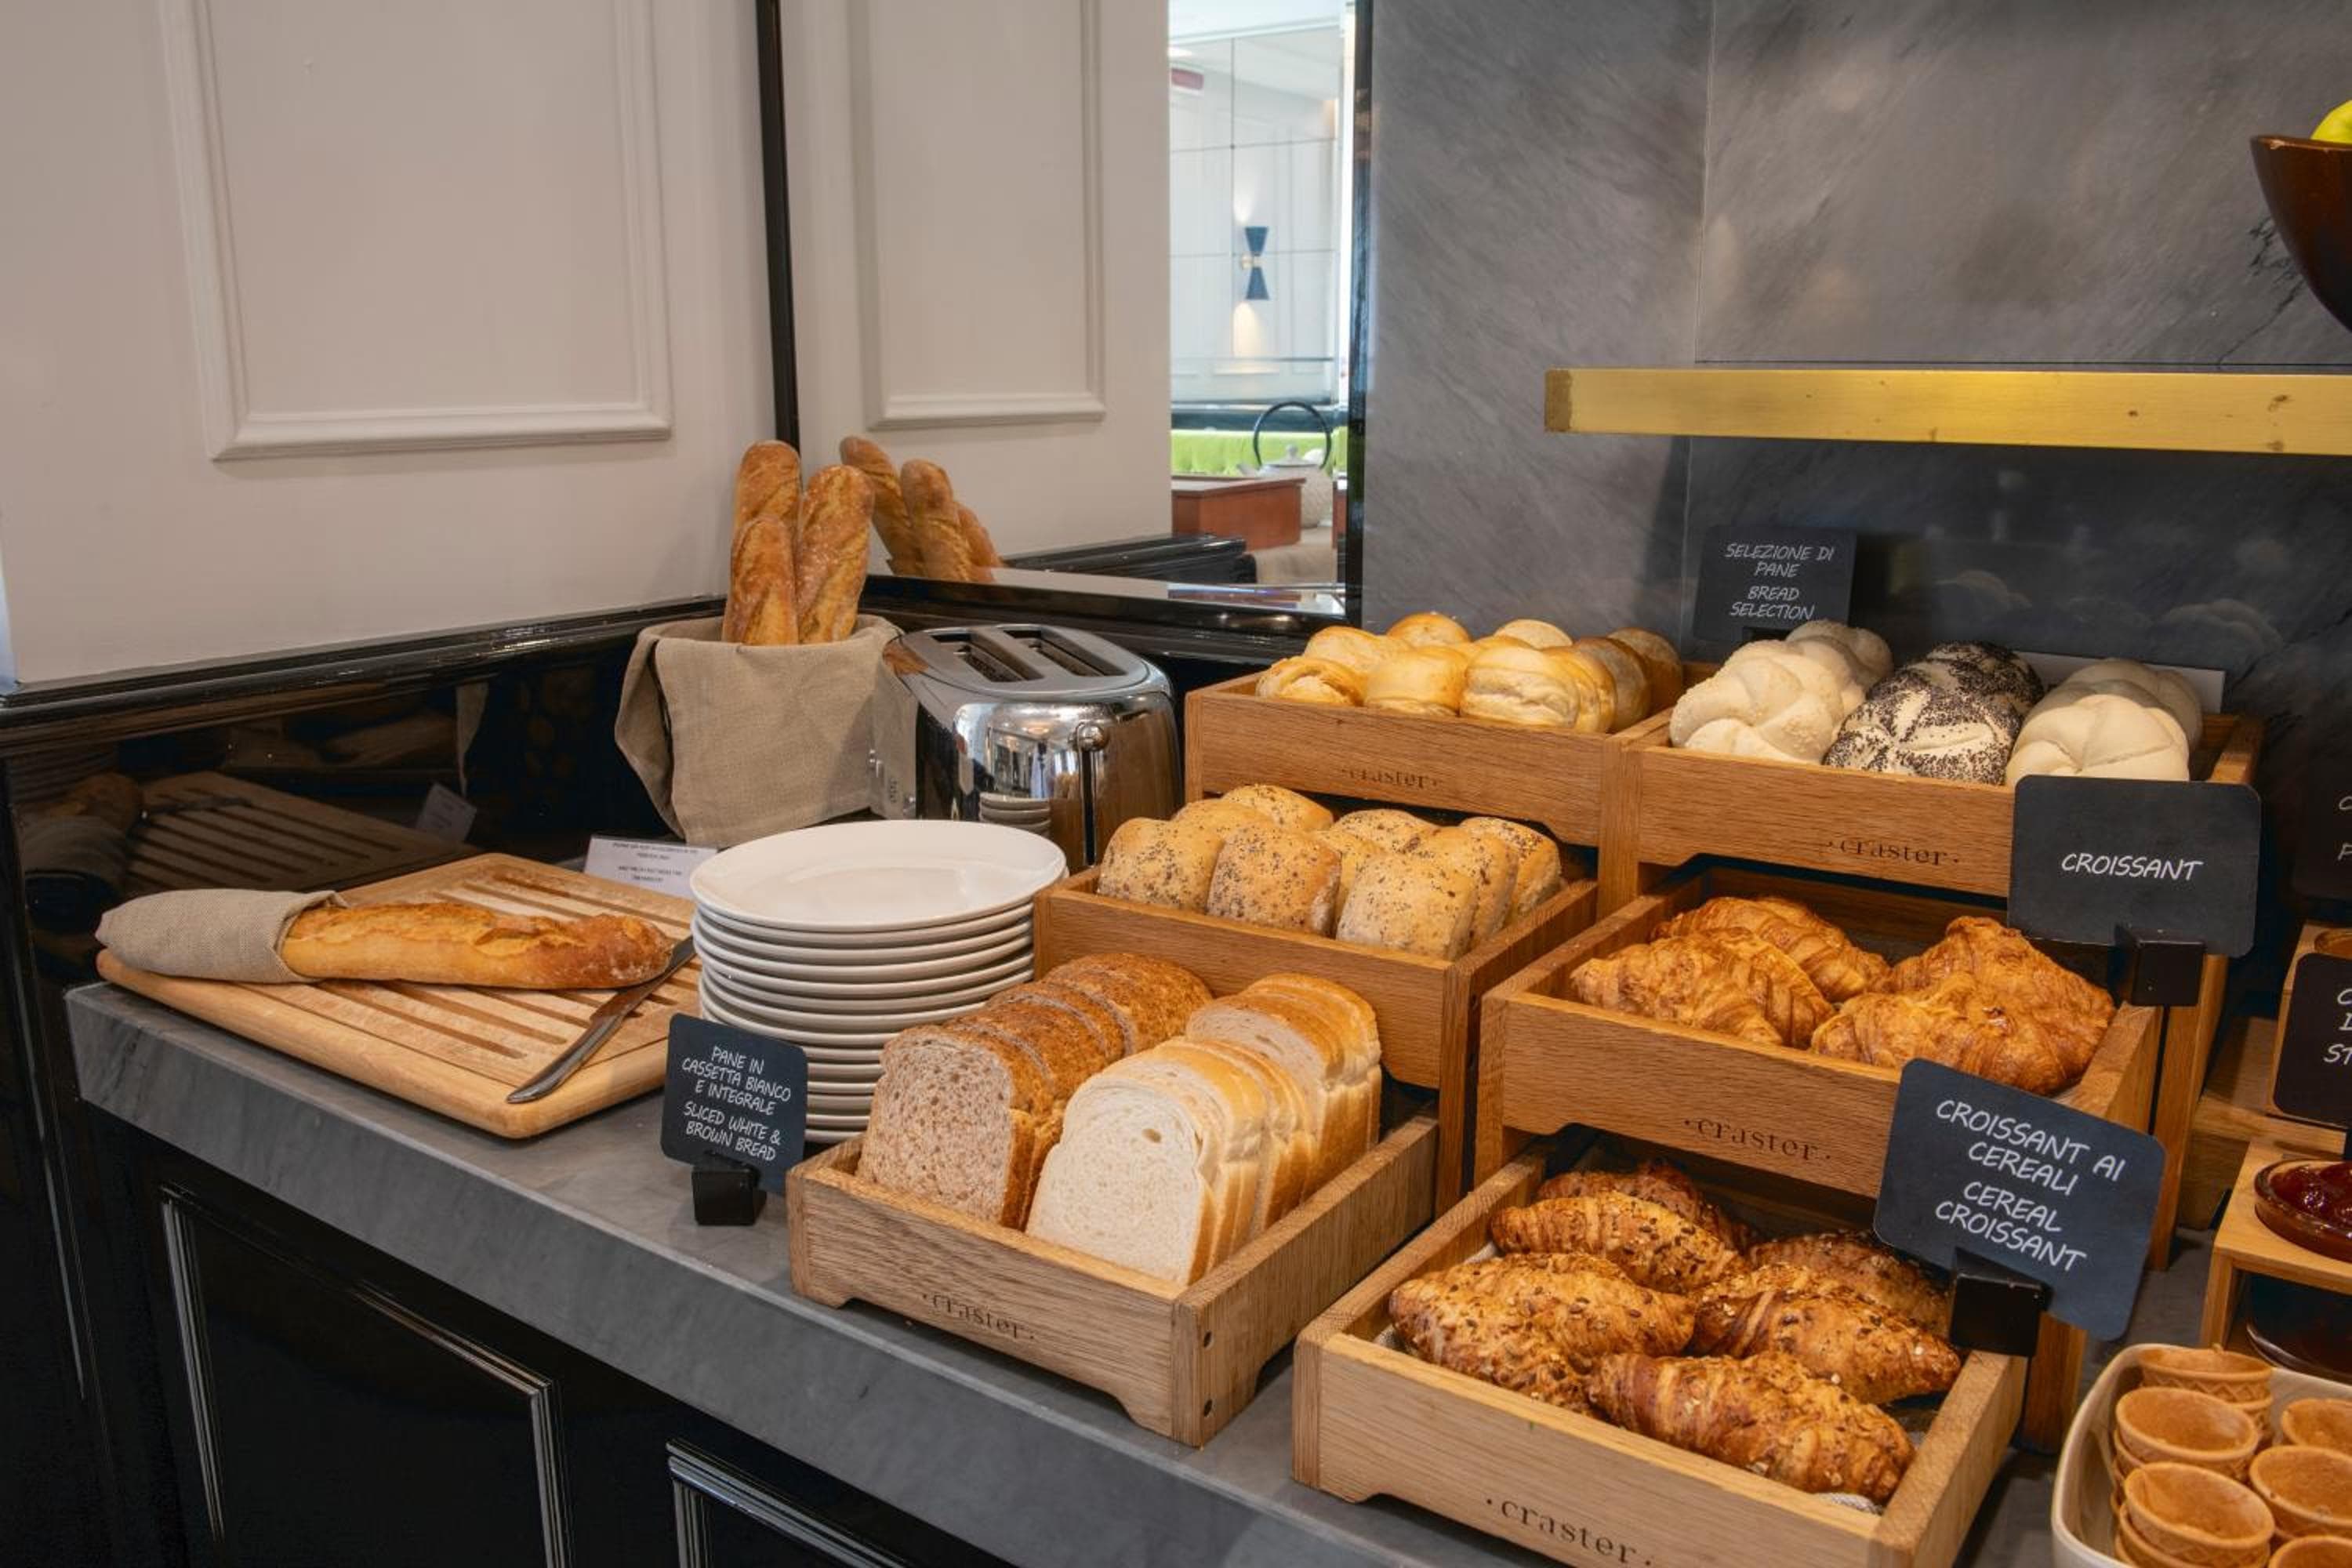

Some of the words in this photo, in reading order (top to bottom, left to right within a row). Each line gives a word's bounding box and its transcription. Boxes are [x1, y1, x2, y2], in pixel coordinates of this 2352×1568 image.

[1724, 543, 1813, 561] SELEZIONE
[1816, 546, 1834, 561] DI
[1754, 562, 1800, 577] PANE
[1729, 602, 1815, 620] SELECTION
[1748, 586, 1799, 601] BREAD
[2061, 852, 2204, 881] CROISSANT
[711, 1046, 746, 1069] PANE
[750, 1058, 764, 1075] IN
[681, 1058, 742, 1087] CASSETTA
[746, 1076, 791, 1102] BIANCO
[695, 1080, 705, 1094] E
[709, 1084, 776, 1116] INTEGRALE
[683, 1101, 724, 1125] SLICED
[729, 1116, 768, 1140] WHITE
[770, 1130, 782, 1146] &
[686, 1121, 733, 1147] BROWN
[735, 1138, 776, 1161] BREAD
[1936, 1099, 2091, 1164] CROISSANT
[2092, 1154, 2126, 1181] AI
[1968, 1141, 2078, 1196] CEREALI
[1963, 1181, 2063, 1232] CEREAL
[1935, 1201, 2087, 1272] CROISSANT
